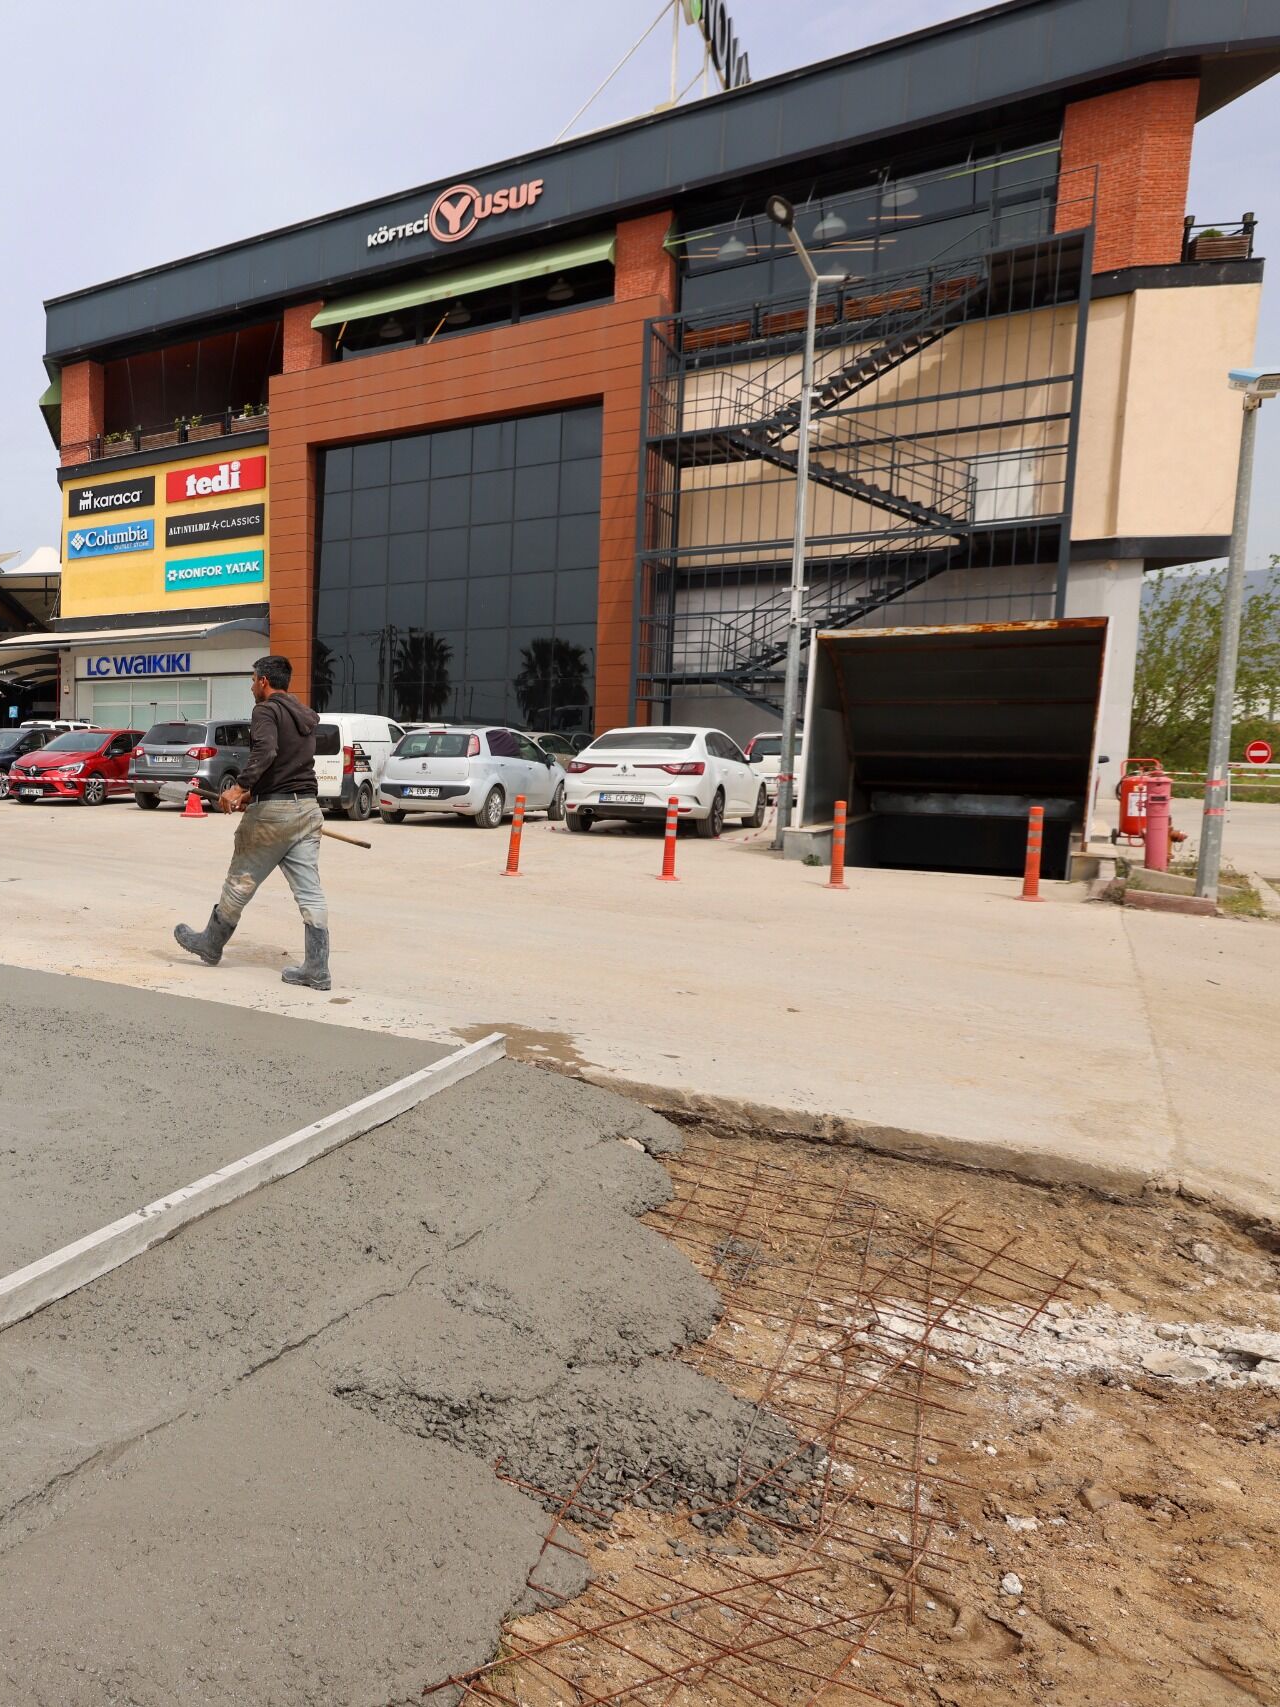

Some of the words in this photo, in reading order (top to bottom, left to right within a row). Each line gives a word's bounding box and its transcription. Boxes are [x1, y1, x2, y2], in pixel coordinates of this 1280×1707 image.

[367, 214, 428, 247] KÖFTECİ
[438, 179, 544, 234] YUSUF
[186, 461, 240, 496] tedi
[220, 515, 260, 528] CLASSICS
[85, 526, 148, 547] Columbia
[178, 565, 223, 579] KONFOR
[225, 560, 260, 574] YATAK
[87, 656, 111, 675] LC
